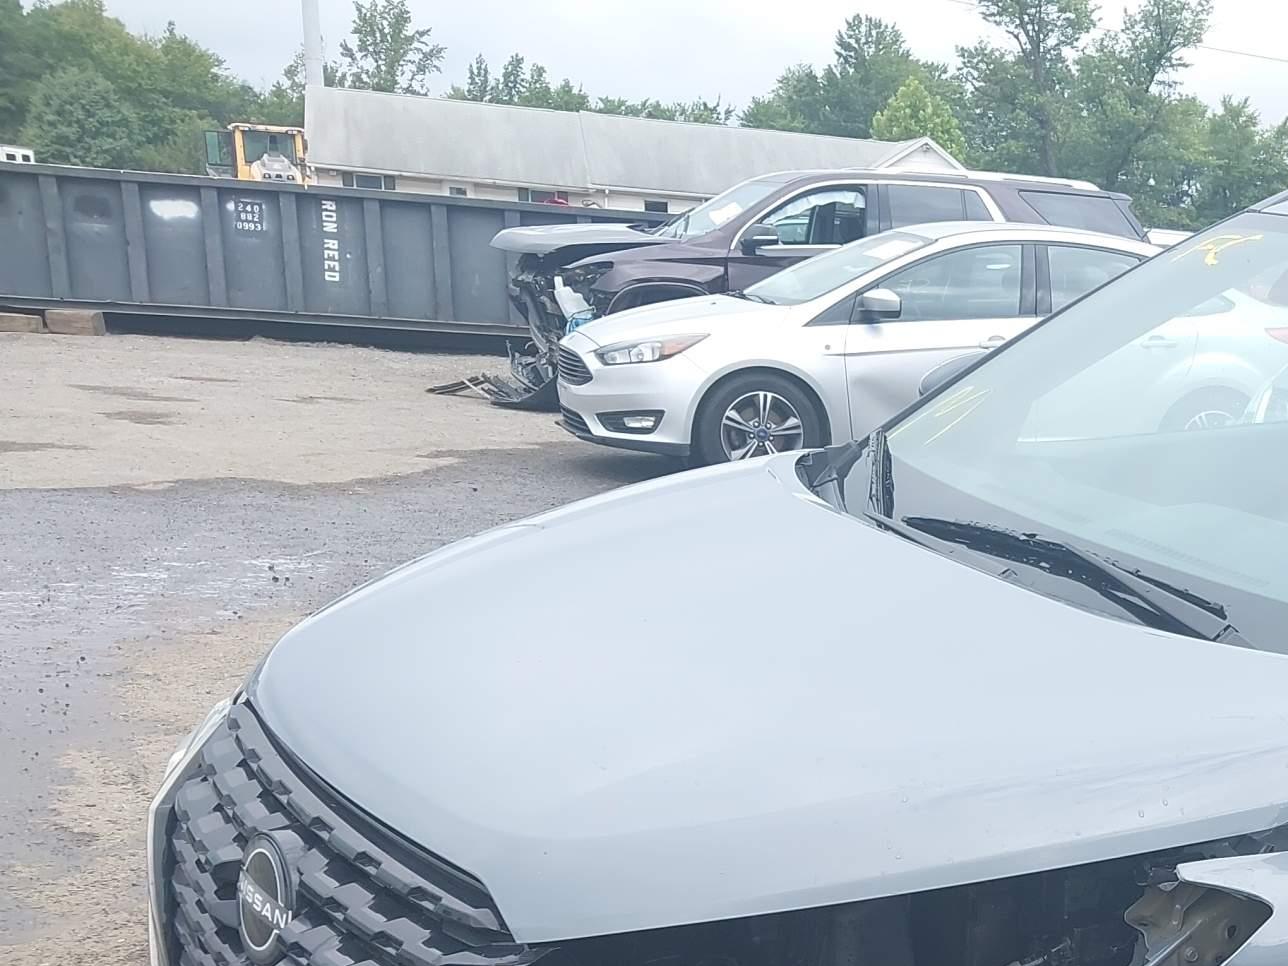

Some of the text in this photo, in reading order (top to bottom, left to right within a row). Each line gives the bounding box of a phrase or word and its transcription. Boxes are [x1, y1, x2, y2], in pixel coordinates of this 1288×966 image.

[237, 202, 260, 213] 240
[321, 200, 340, 281] RON REED
[239, 872, 288, 929] NISSAN
